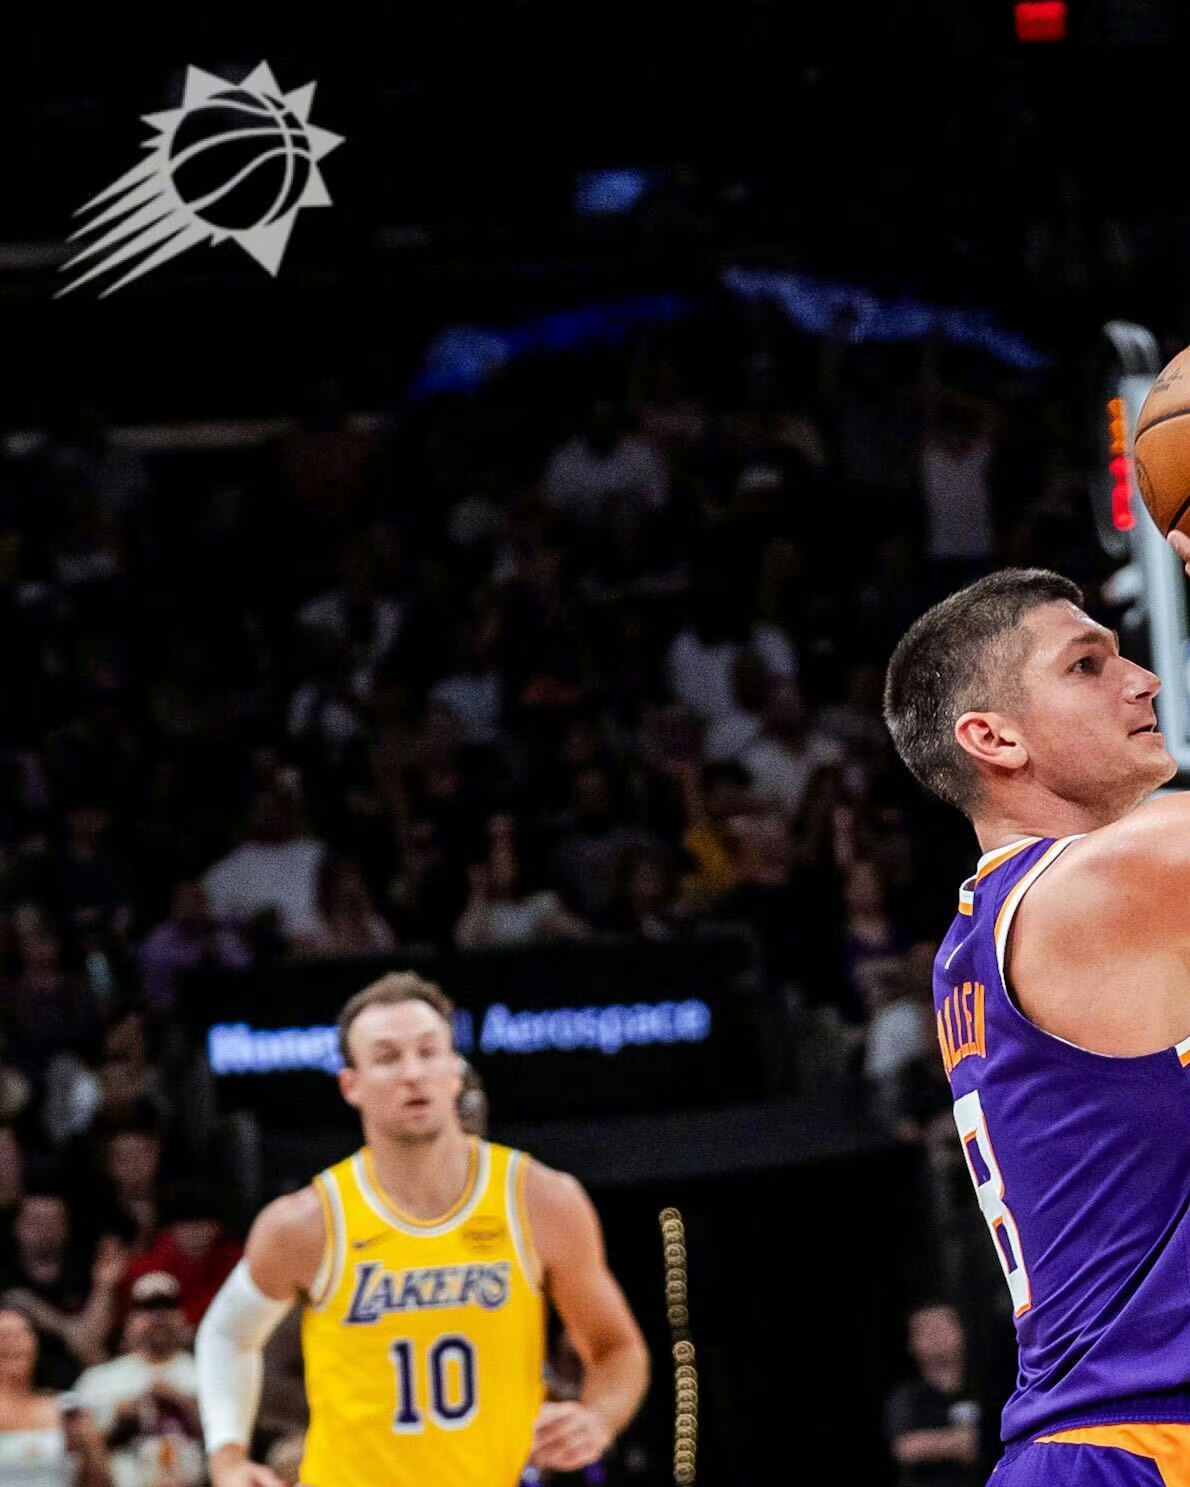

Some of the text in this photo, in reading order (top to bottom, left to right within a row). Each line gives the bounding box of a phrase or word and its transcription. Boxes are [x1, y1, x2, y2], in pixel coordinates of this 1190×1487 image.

[479, 998, 712, 1054] Aerospace
[343, 1260, 512, 1325] LAKERS
[389, 1333, 479, 1433] 10
